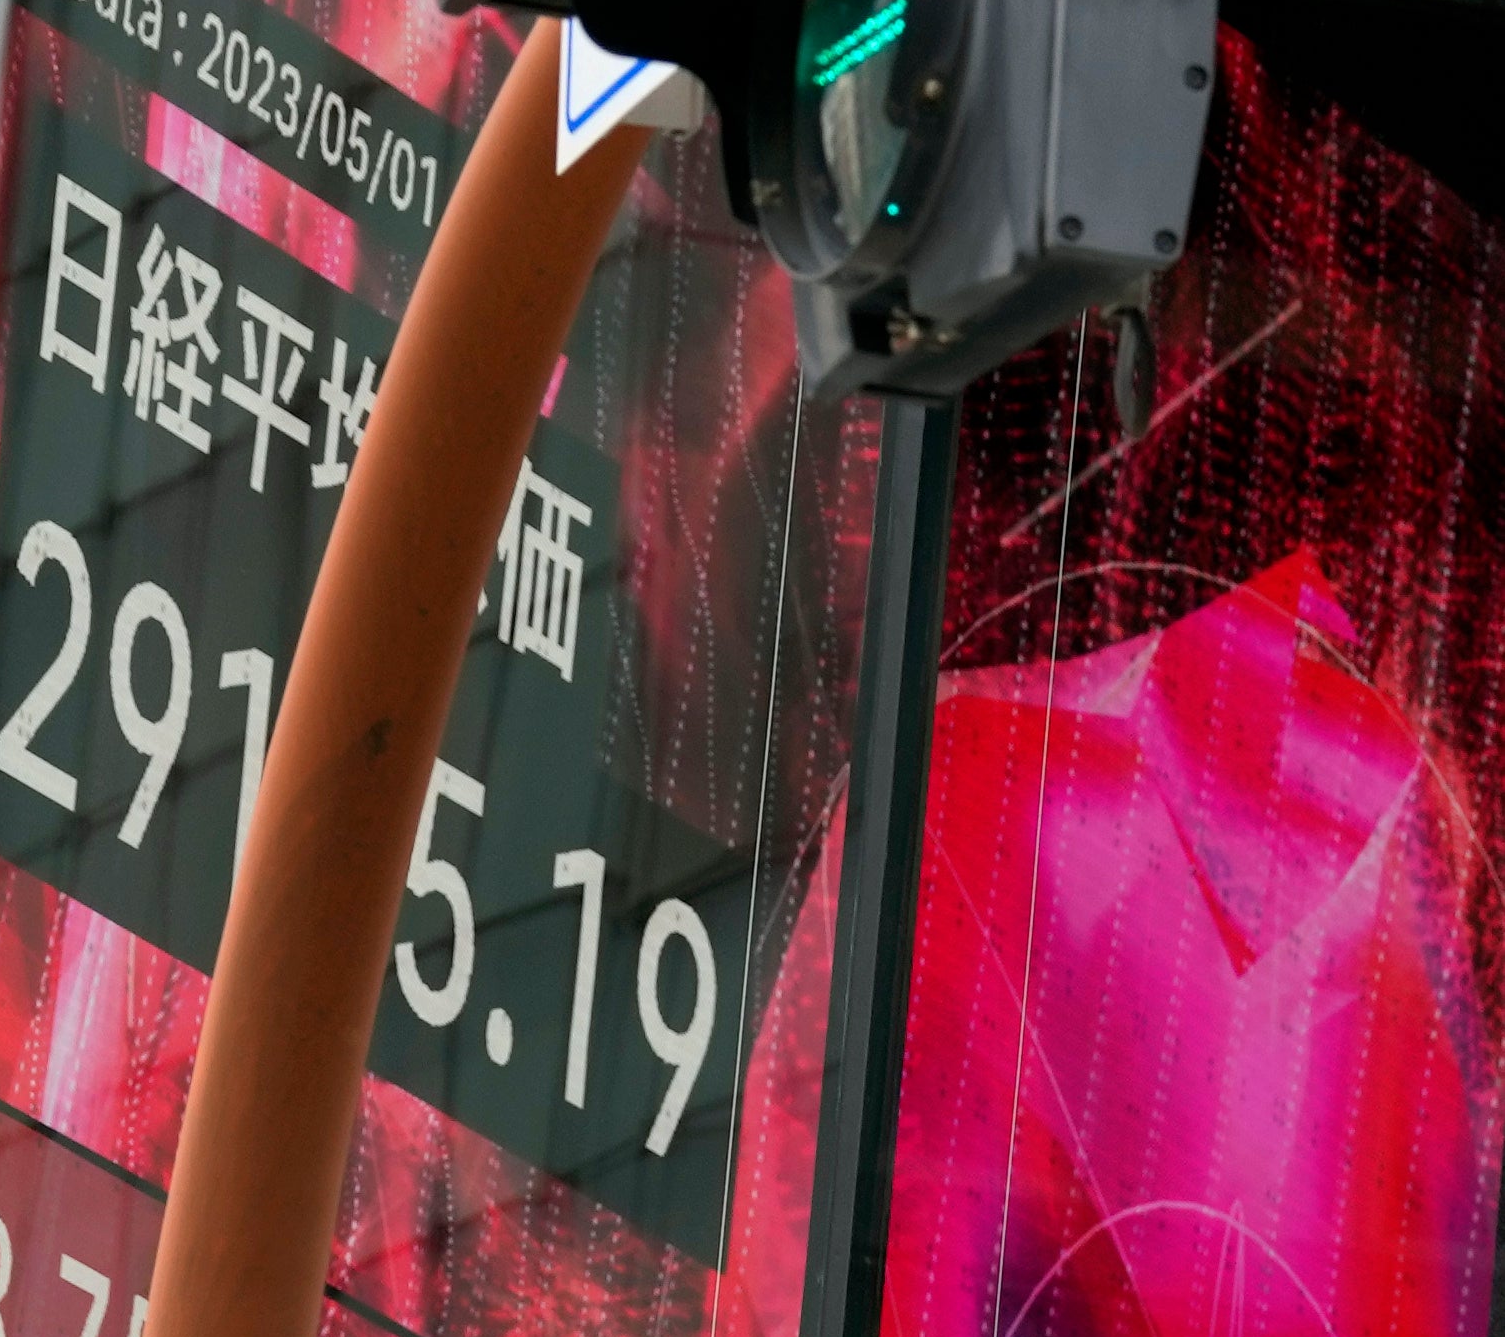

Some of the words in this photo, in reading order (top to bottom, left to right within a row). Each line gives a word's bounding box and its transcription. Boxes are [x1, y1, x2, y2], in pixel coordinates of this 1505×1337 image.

[196, 12, 439, 228] 2023/05/01
[40, 174, 592, 683] 日経平均価
